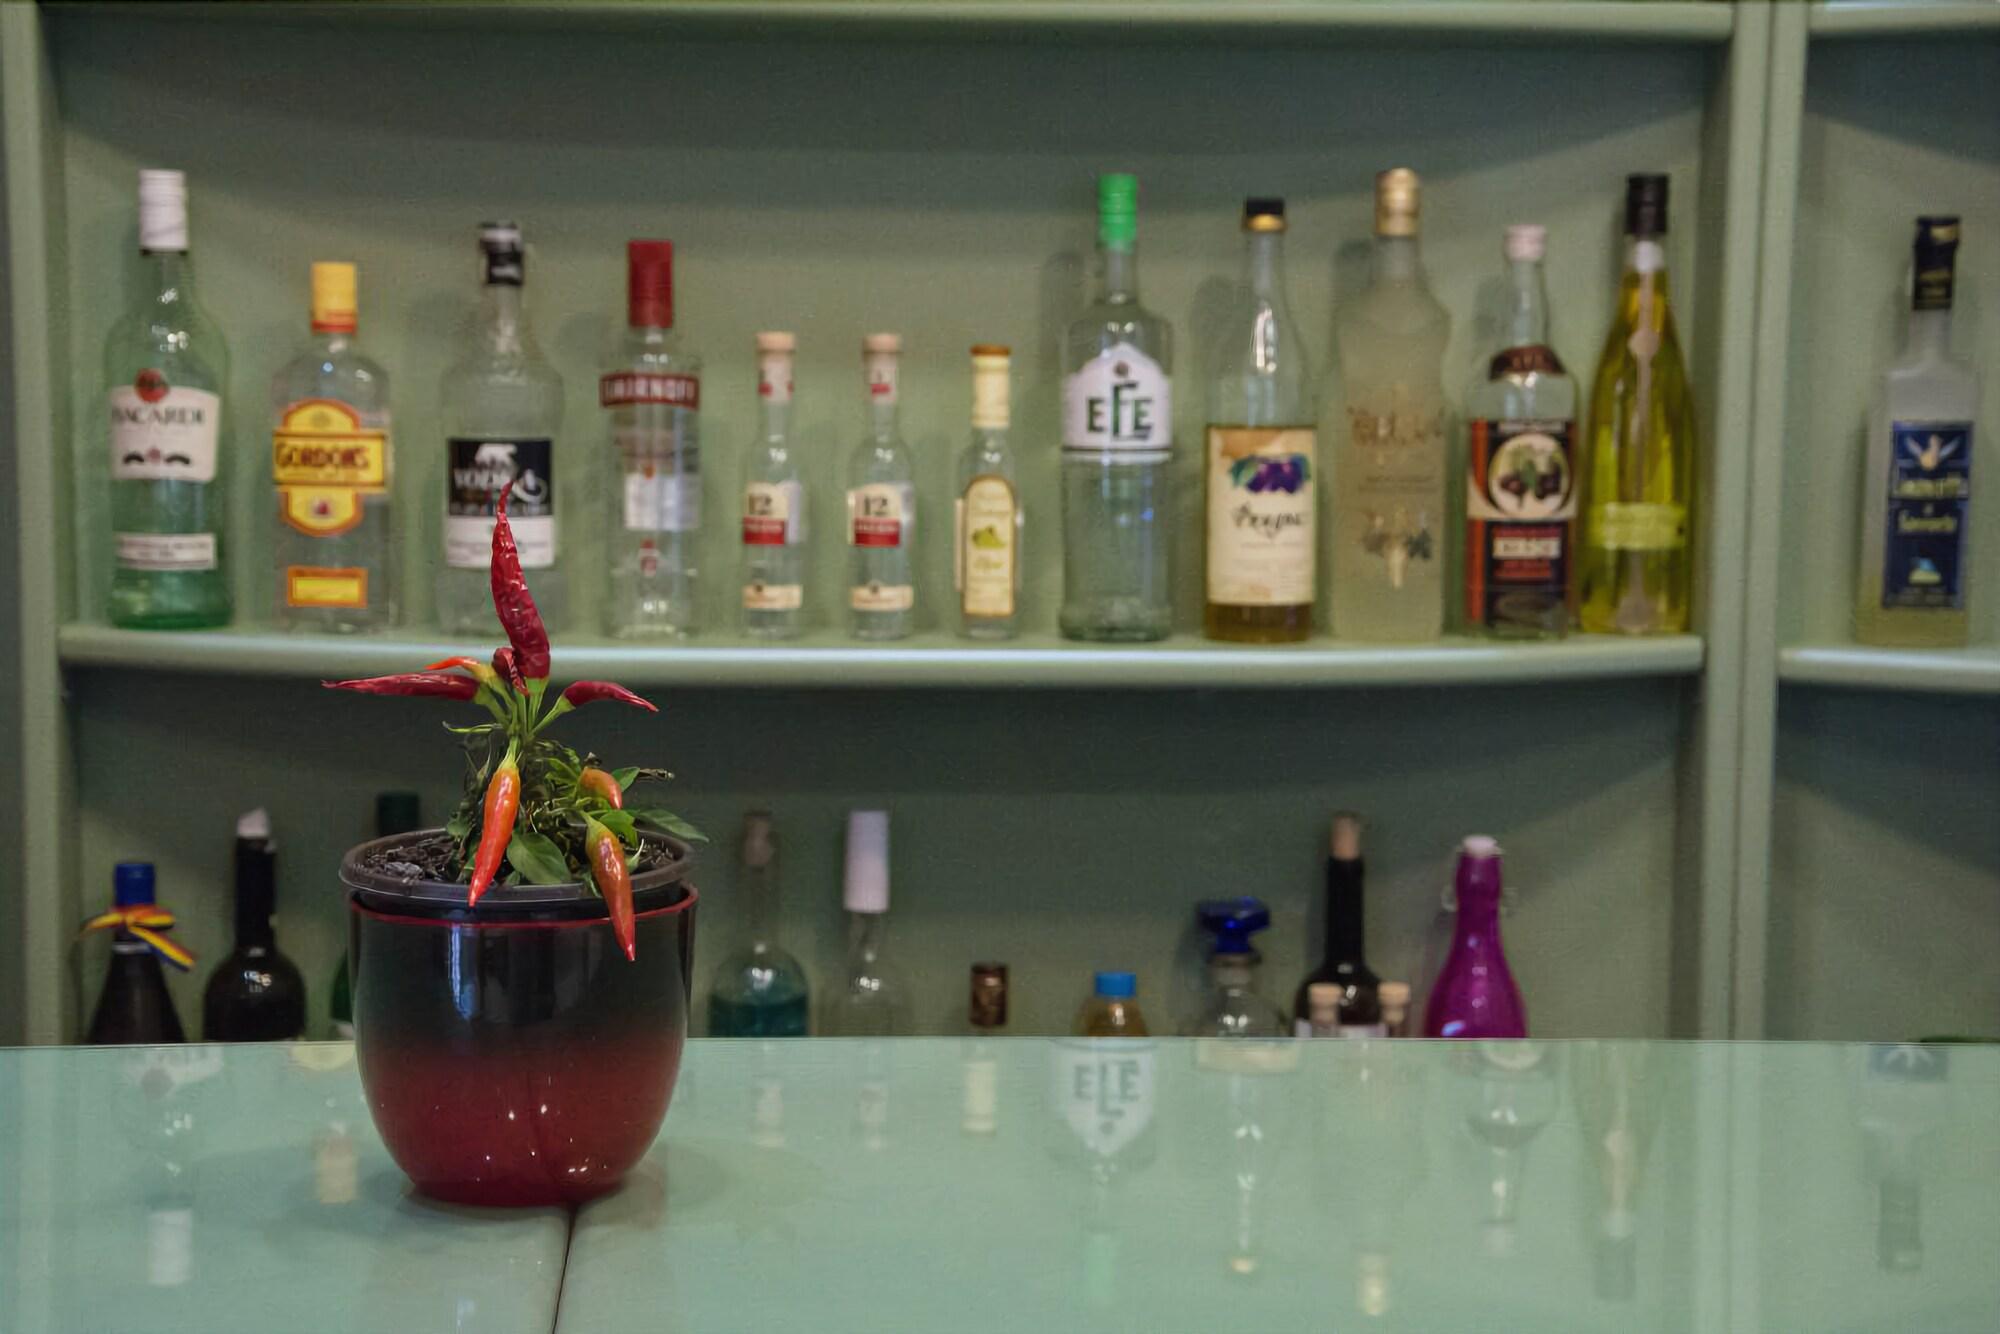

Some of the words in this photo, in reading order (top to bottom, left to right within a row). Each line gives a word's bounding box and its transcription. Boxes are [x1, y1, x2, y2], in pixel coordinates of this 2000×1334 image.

[112, 406, 205, 425] BACARDI
[1087, 383, 1153, 440] EFE
[863, 496, 888, 516] 12
